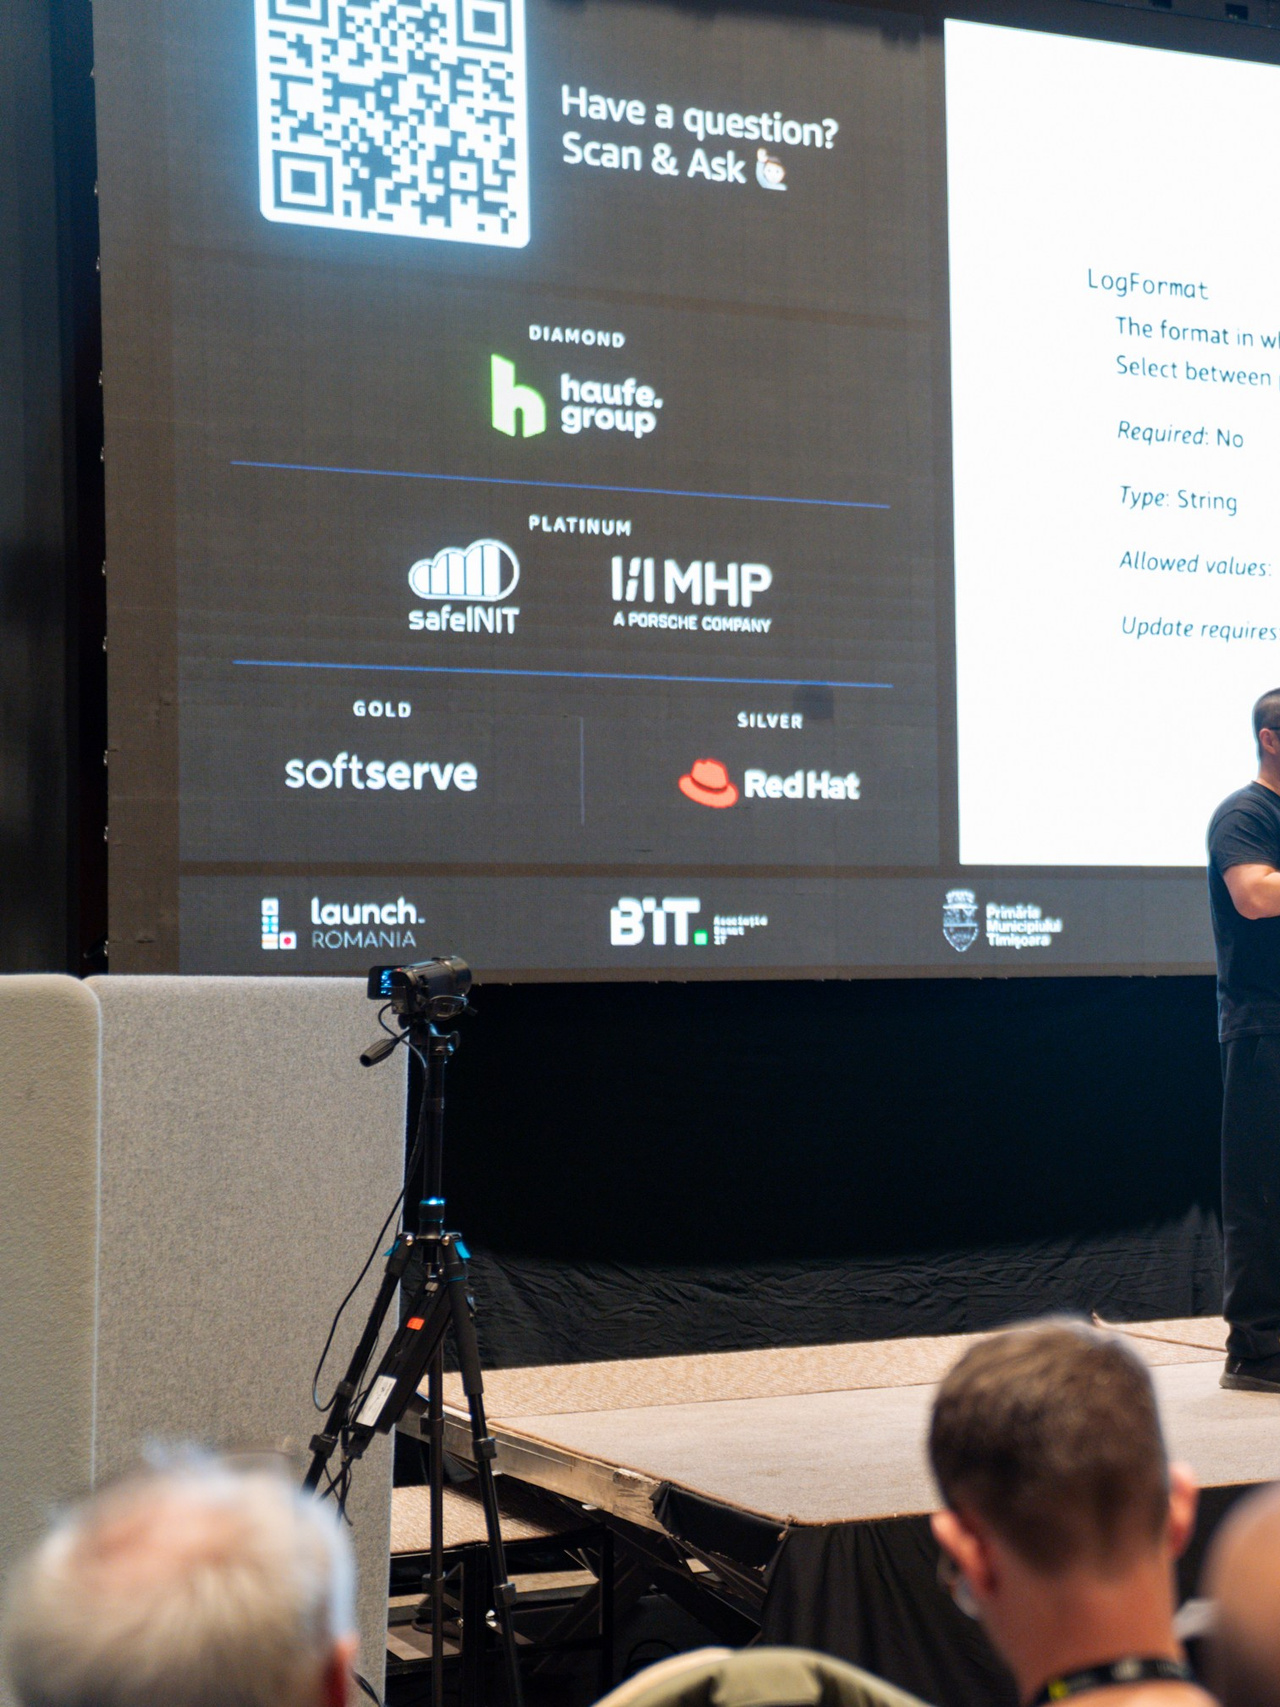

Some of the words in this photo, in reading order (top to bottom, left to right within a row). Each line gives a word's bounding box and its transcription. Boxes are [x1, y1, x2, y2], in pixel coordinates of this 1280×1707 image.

[562, 84, 646, 125] Have
[655, 104, 673, 129] a
[683, 107, 839, 149] question?
[563, 131, 642, 171] Scan
[651, 143, 679, 176] &
[687, 148, 746, 183] Ask
[1088, 268, 1208, 300] LogFormat
[529, 325, 625, 348] DIAMOND
[1116, 316, 1152, 338] The
[1160, 319, 1229, 345] format
[1237, 328, 1254, 347] in
[1116, 355, 1177, 379] Select
[1186, 361, 1271, 385] between
[561, 373, 663, 409] haufe.
[561, 403, 658, 438] group
[1118, 421, 1208, 445] Required:
[1217, 428, 1243, 448] No
[1120, 485, 1171, 511] Type:
[1178, 490, 1237, 516] String
[529, 515, 631, 536] PLATINUM
[1120, 551, 1199, 572] Allowed
[1206, 556, 1273, 577] values:
[664, 560, 772, 607] MHP
[614, 612, 625, 626] A
[628, 612, 697, 630] PORSCHE
[702, 616, 771, 633] COMPANY
[1122, 616, 1193, 639] Update
[353, 700, 411, 718] GOLD
[738, 712, 802, 729] SILVER
[285, 752, 477, 791] softserve
[313, 930, 416, 948] ROMANIA
